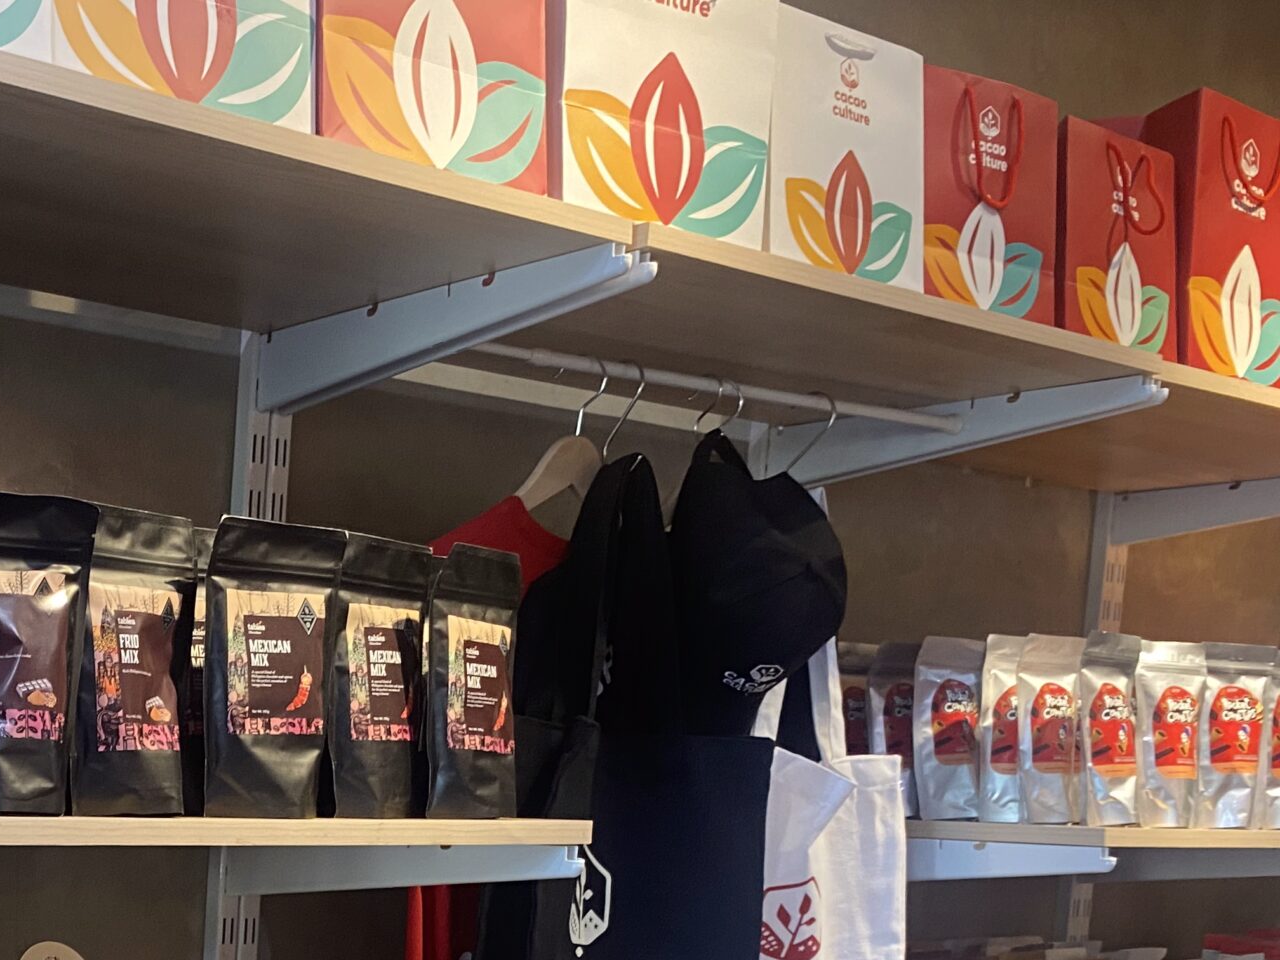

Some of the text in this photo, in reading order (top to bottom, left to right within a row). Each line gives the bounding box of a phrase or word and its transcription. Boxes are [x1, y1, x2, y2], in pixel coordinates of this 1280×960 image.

[654, 0, 711, 17] lture
[834, 90, 867, 109] cacao
[832, 104, 870, 126] culture
[969, 153, 1008, 172] clture
[249, 639, 291, 653] MEXICAN
[121, 650, 140, 664] MIX
[251, 654, 269, 667] MIX
[369, 650, 402, 664] MEXICAN
[370, 664, 387, 676] MIX
[466, 663, 497, 678] MEXICAN
[467, 676, 482, 689] MIX
